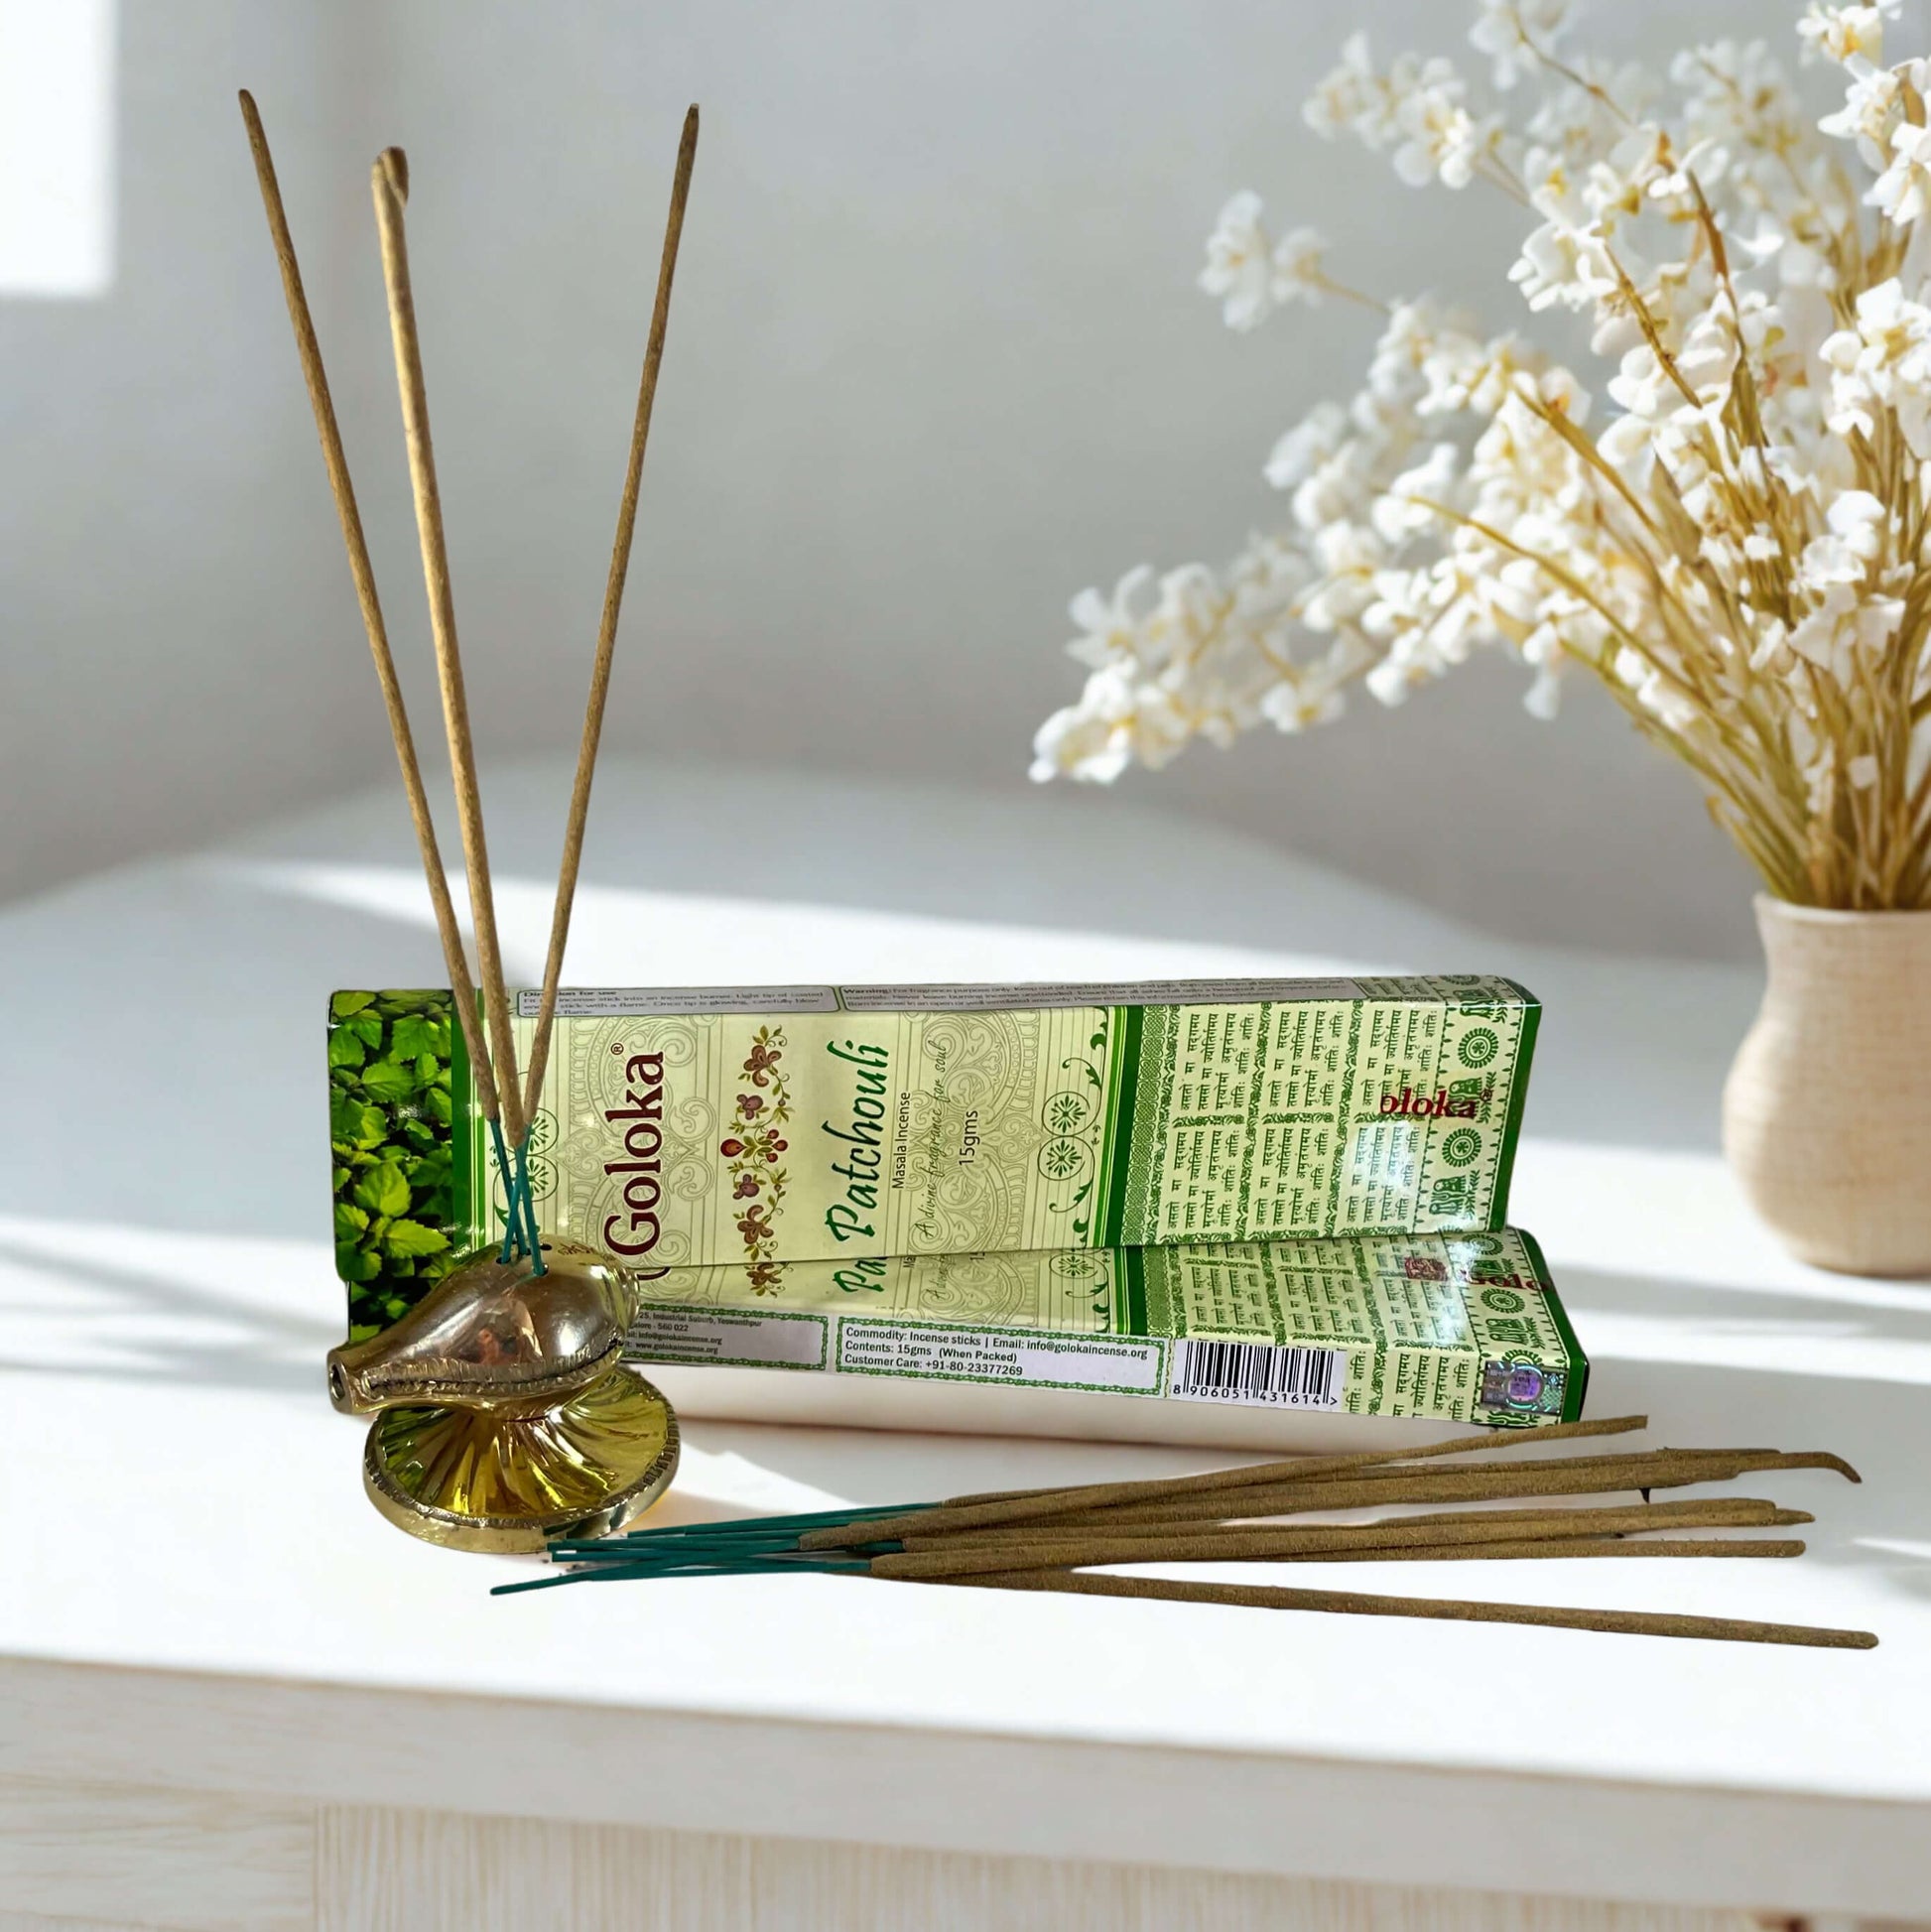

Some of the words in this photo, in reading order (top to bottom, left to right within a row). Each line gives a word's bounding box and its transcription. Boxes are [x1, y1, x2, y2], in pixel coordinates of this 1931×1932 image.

[895, 1092, 911, 1141] Incense
[821, 1040, 890, 1242] Patchouli
[959, 1110, 980, 1166] 15gms
[892, 1144, 908, 1190] Masala
[653, 1313, 687, 1323] Industrial
[688, 1315, 716, 1325] Suburb,
[674, 1323, 689, 1332] 022
[844, 1341, 894, 1353] Contents:
[897, 1344, 932, 1357] 15gms
[939, 1347, 973, 1360] (When
[975, 1350, 1017, 1363] Packed)
[845, 1327, 907, 1344] Commodity:
[909, 1332, 950, 1344] Incense
[951, 1334, 981, 1347] sticks
[993, 1338, 1025, 1350] Email:
[1027, 1340, 1148, 1360] info@golokaincense.org
[844, 1353, 893, 1367] Customer
[896, 1356, 923, 1369] Care:
[925, 1358, 1023, 1376] +91-80-23377269
